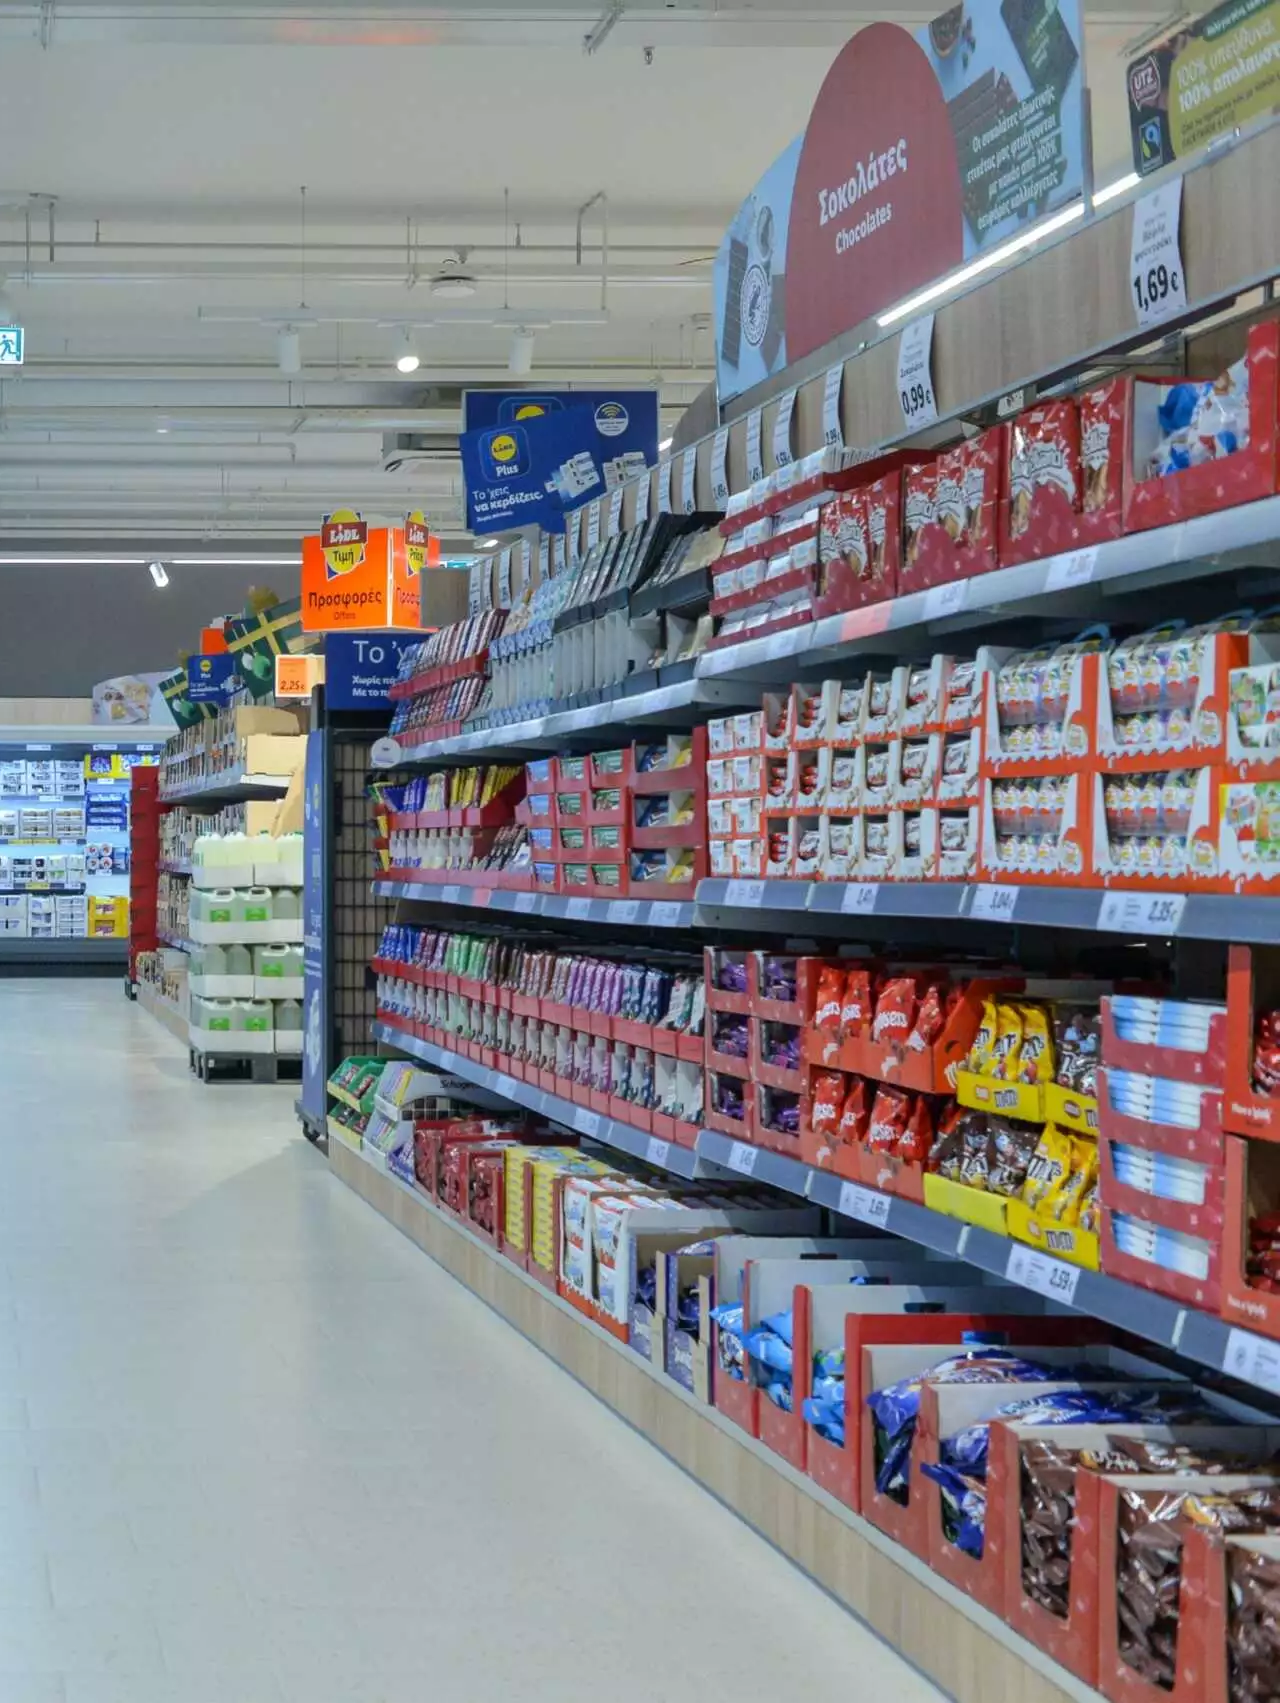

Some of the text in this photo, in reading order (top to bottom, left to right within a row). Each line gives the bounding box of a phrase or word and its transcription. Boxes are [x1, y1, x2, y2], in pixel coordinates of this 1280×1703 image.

[1133, 67, 1153, 90] UTZ
[818, 138, 908, 226] Σοκολάτες
[835, 202, 892, 255] Chocolates
[1133, 264, 1169, 312] 1,69
[902, 383, 924, 417] 0,99
[495, 463, 520, 478] Plus
[472, 489, 486, 501] Το
[473, 501, 490, 513] να
[332, 550, 354, 565] Τιμή
[308, 587, 382, 611] Προσφορές
[352, 640, 386, 664] Το
[352, 674, 381, 687] Χωρίς
[352, 688, 367, 698] Με
[368, 688, 380, 698] το
